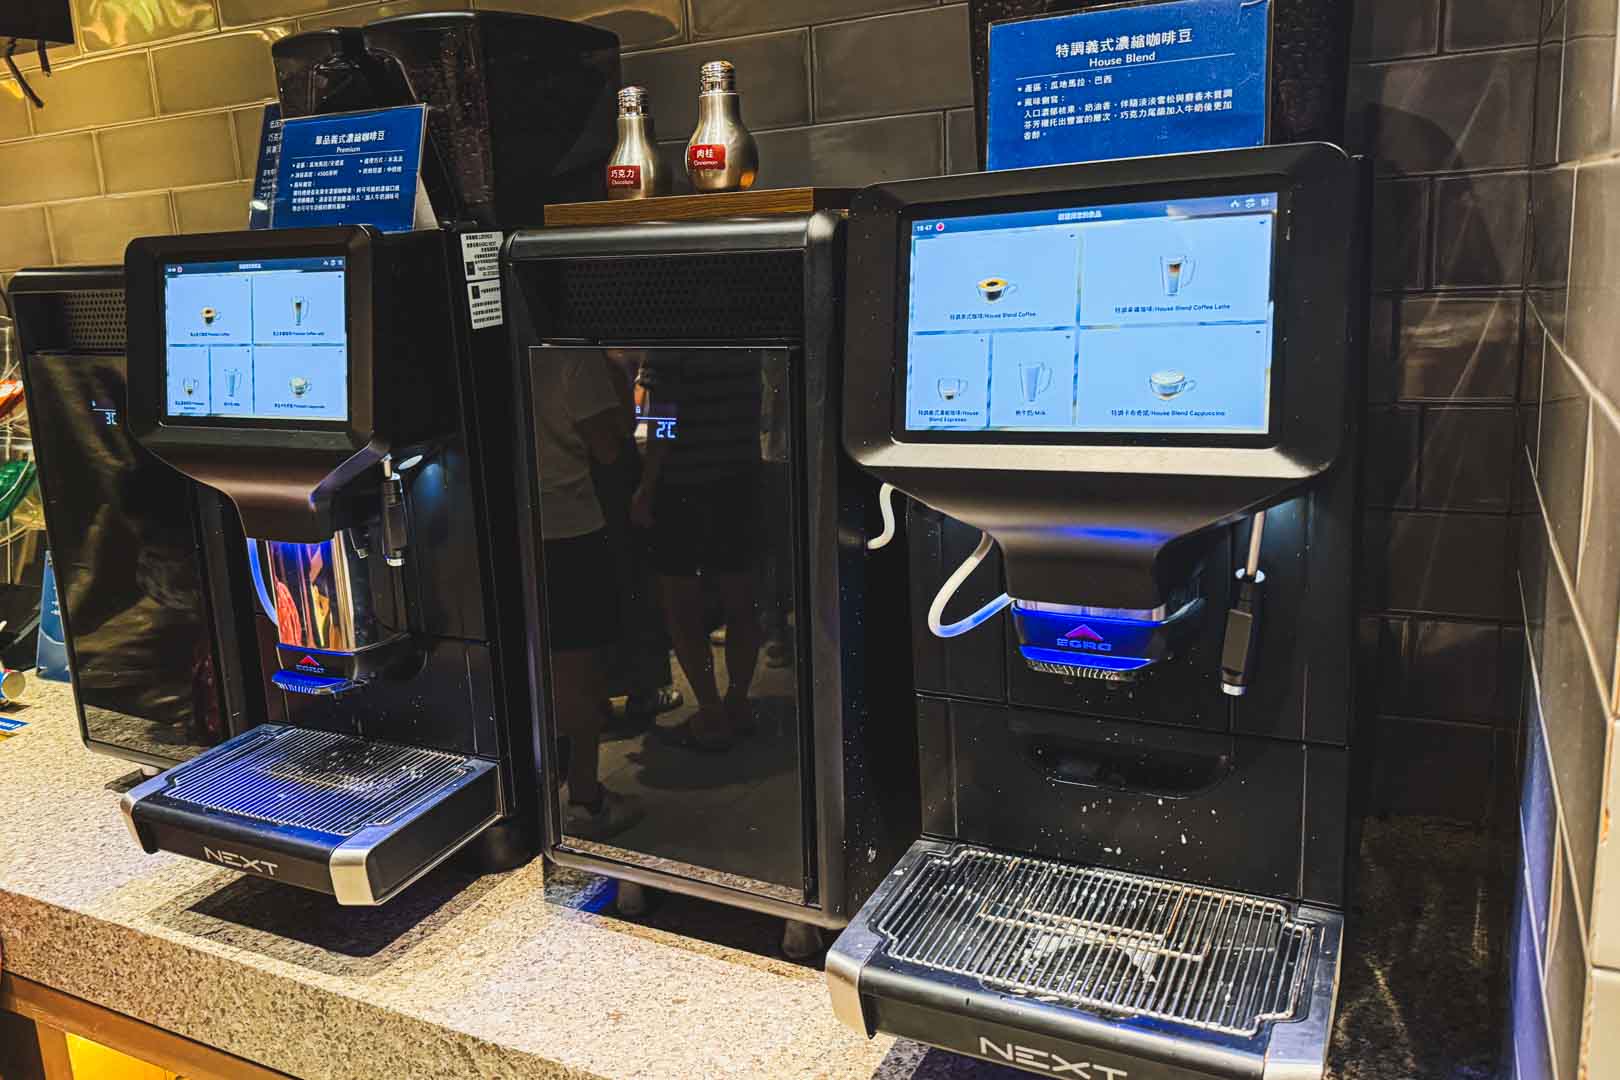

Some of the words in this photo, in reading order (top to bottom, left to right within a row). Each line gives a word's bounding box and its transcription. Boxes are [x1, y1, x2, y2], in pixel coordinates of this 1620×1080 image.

[1055, 28, 1193, 58] 特調義式濃縮咖啡豆
[1089, 57, 1122, 68] House
[1126, 51, 1156, 64] Blend
[696, 148, 713, 159] 肉桂
[611, 169, 635, 179] 巧克力
[1057, 638, 1112, 651] EGRO
[203, 846, 278, 875] NEXT
[979, 1036, 1128, 1080] NEXT
